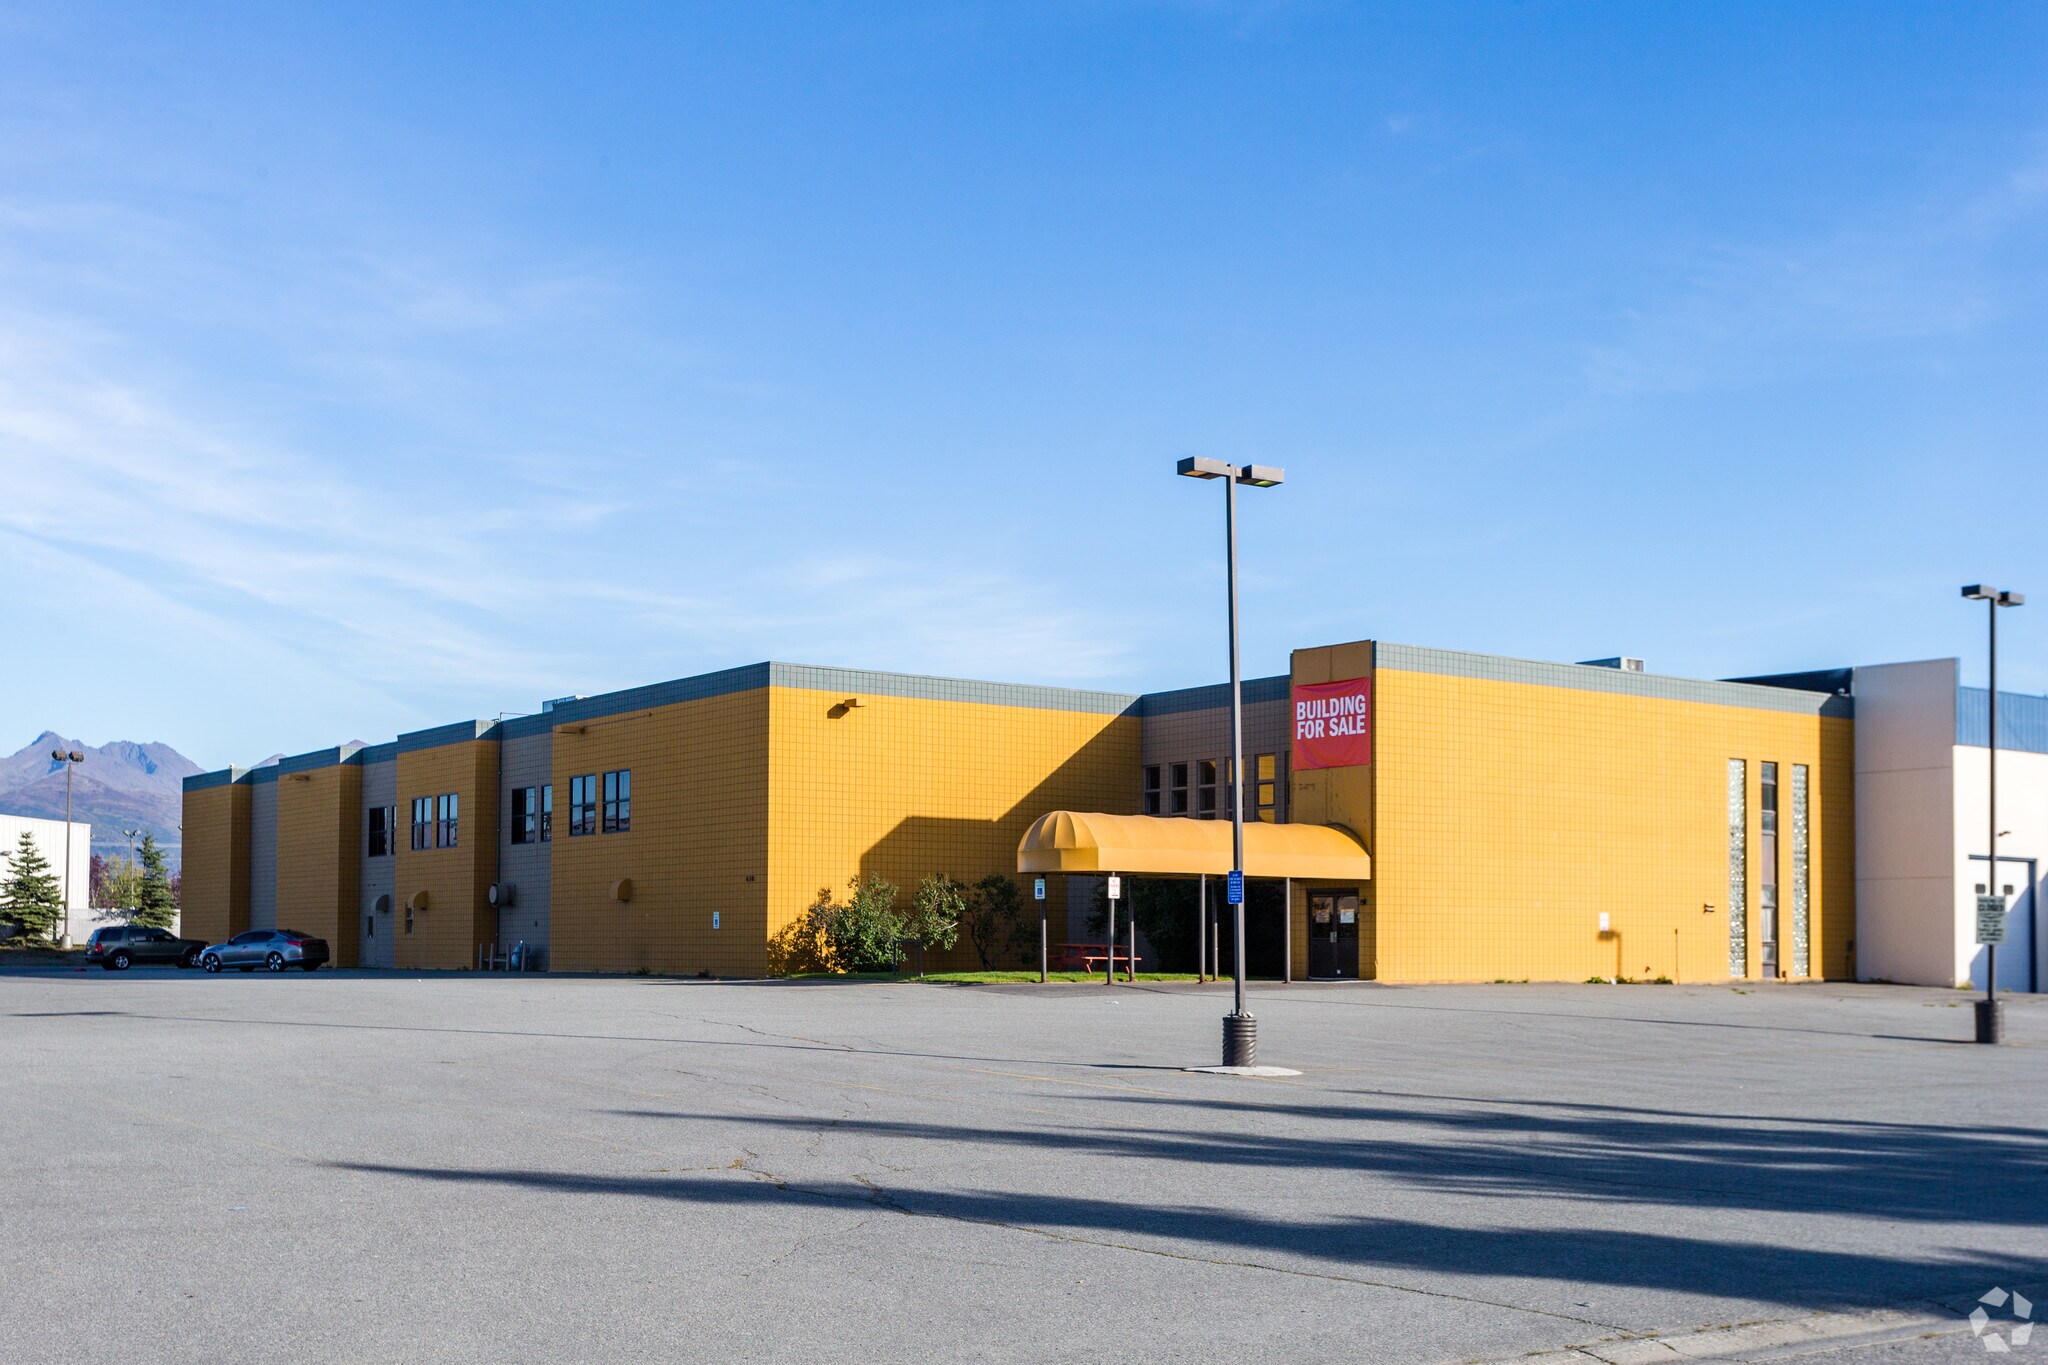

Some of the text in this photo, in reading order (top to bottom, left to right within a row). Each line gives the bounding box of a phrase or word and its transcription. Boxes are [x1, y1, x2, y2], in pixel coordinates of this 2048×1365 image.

[1296, 694, 1366, 720] BUILDING
[1297, 715, 1366, 740] FOR SALE
